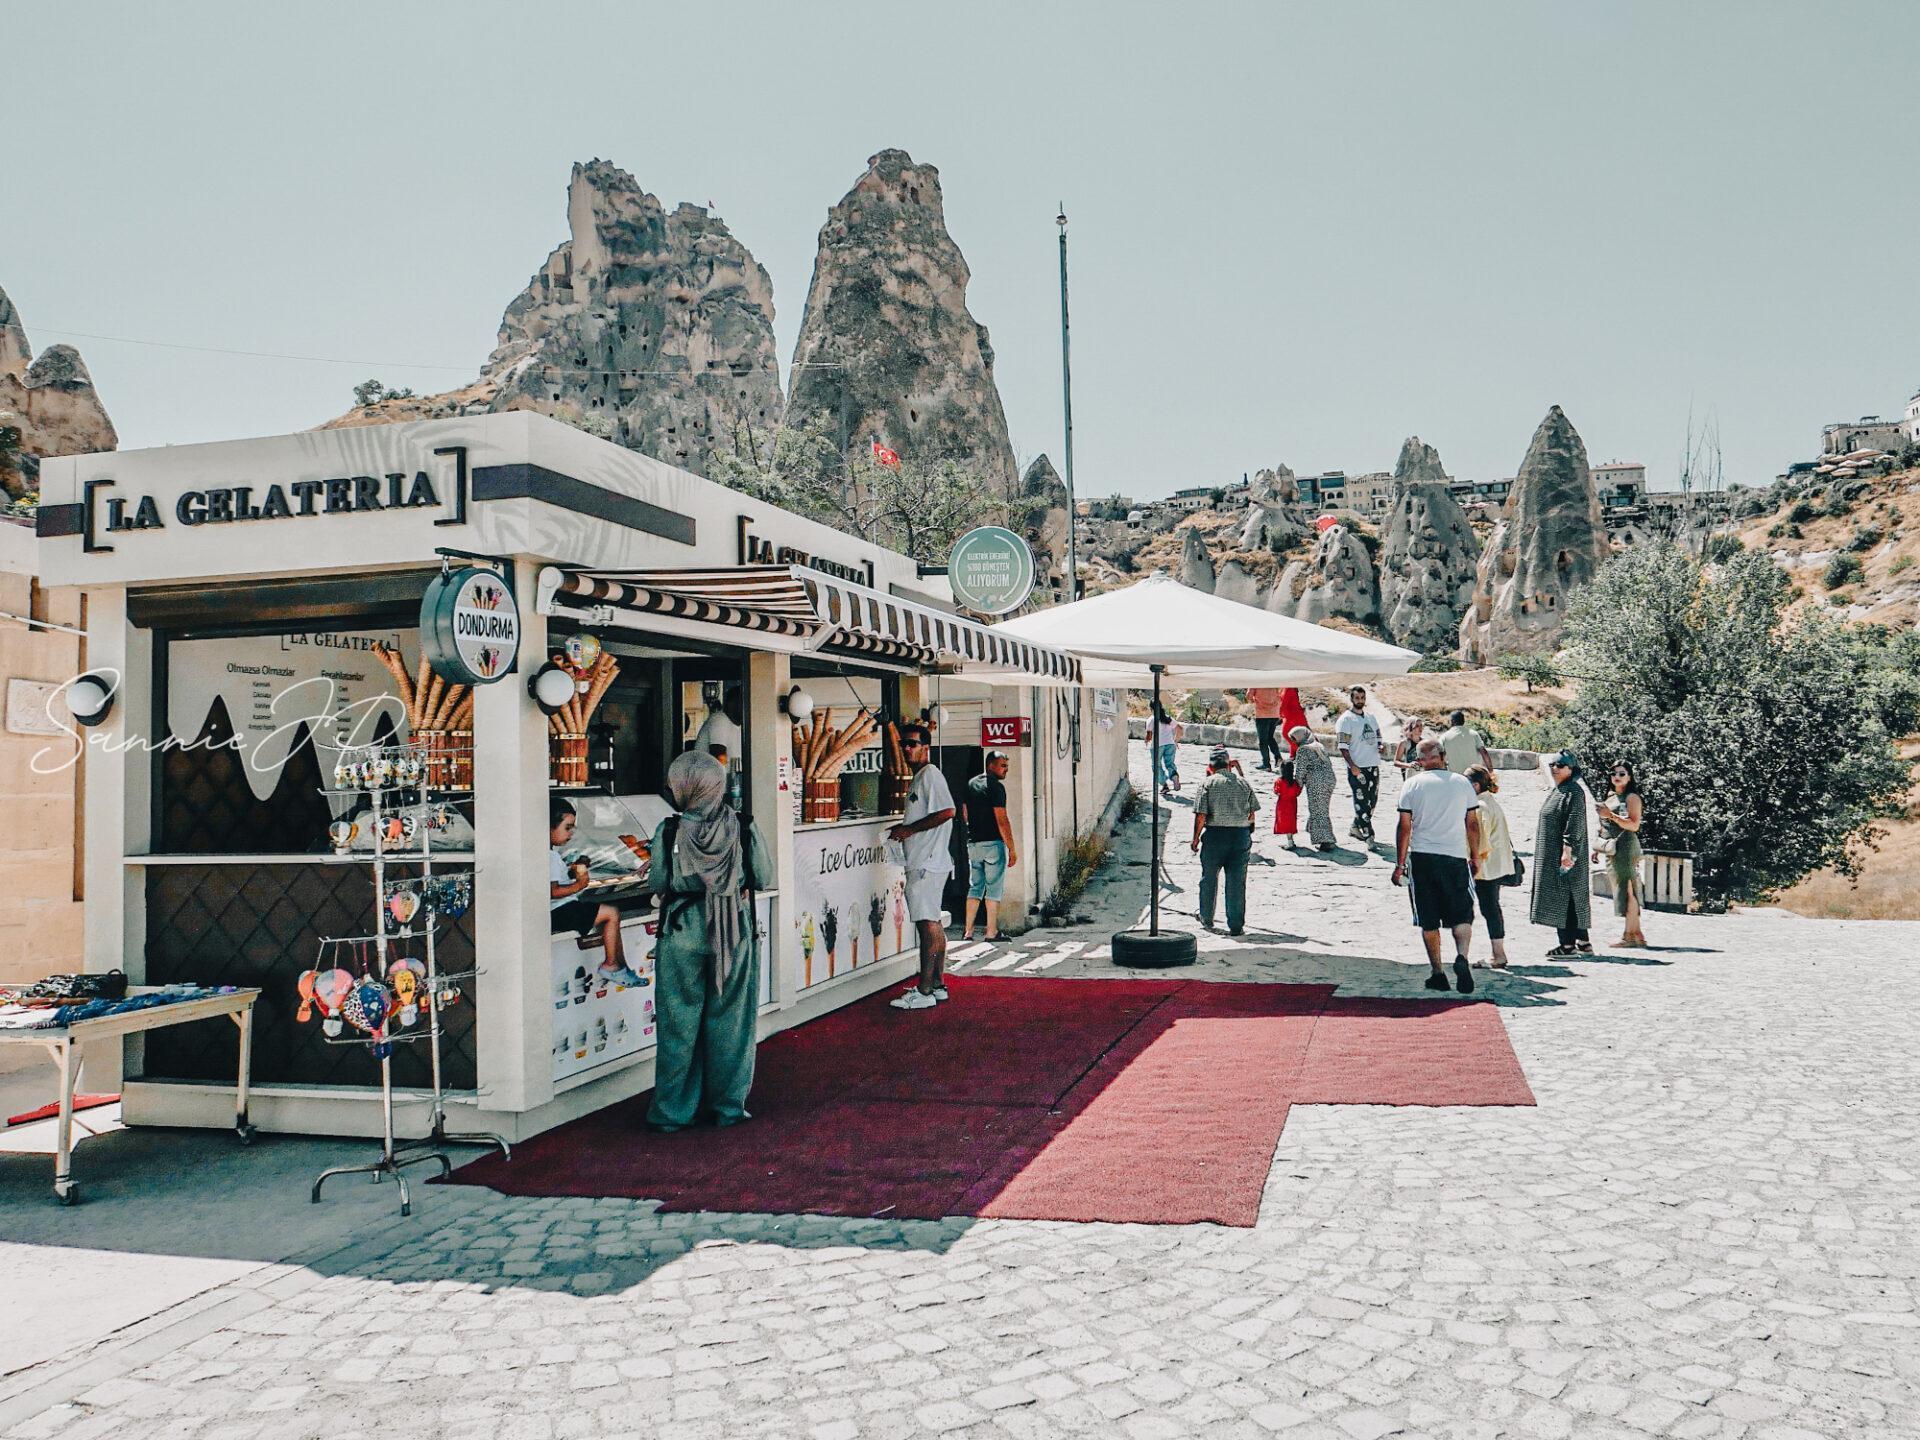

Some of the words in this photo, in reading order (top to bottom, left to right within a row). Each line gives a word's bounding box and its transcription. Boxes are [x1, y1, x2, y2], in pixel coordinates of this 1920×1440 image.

[106, 495, 165, 531] LA
[175, 471, 441, 526] GELATERIA
[748, 535, 775, 565] LA
[290, 633, 308, 645] LA
[458, 612, 514, 640] DONDURMA
[986, 723, 1015, 736] WC
[820, 848, 843, 875] Ice
[844, 843, 885, 869] Cream
